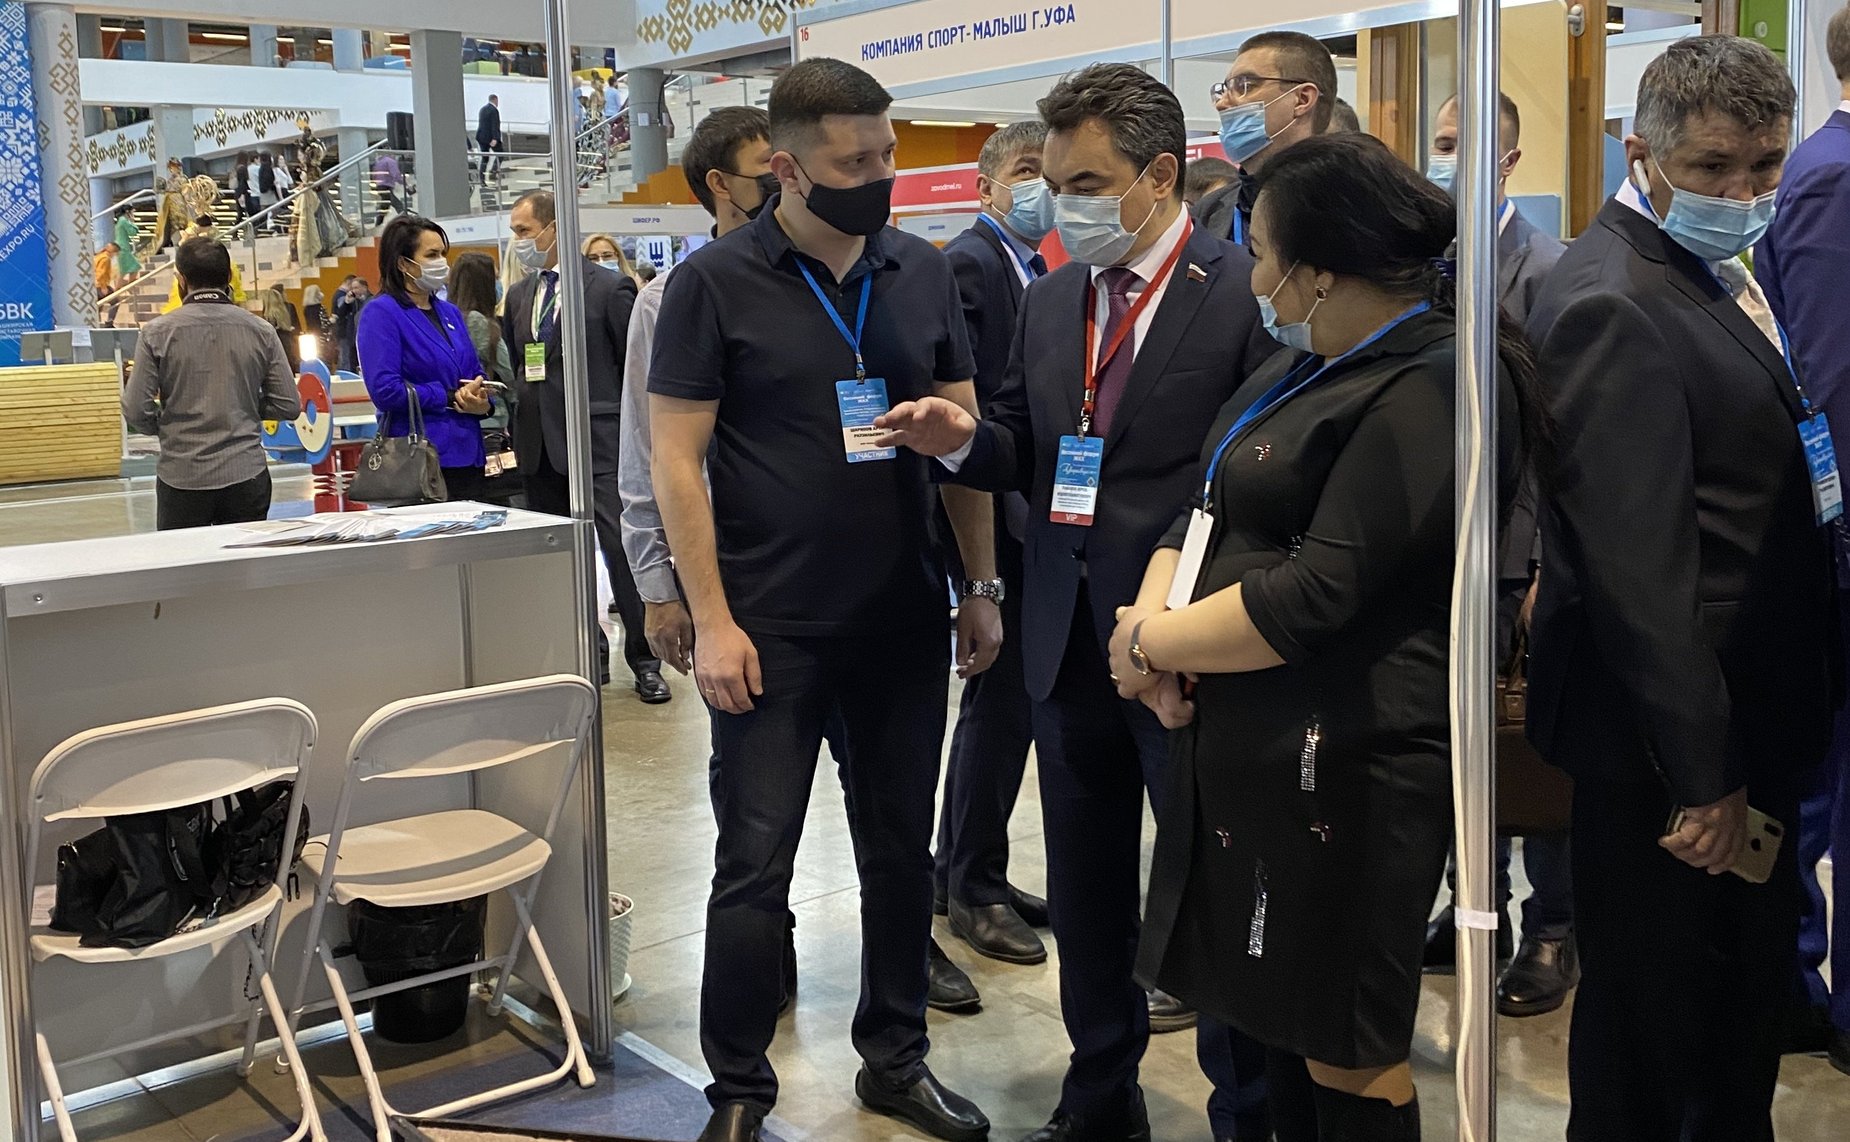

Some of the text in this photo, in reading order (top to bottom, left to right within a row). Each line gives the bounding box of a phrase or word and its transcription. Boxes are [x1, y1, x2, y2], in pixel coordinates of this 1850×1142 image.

[800, 28, 809, 41] 16
[861, 33, 923, 61] КОМПАНИЯ
[0, 223, 35, 262] EXPO.RU
[855, 451, 889, 460] УЧАСТНИК
[1065, 513, 1078, 521] VIP
